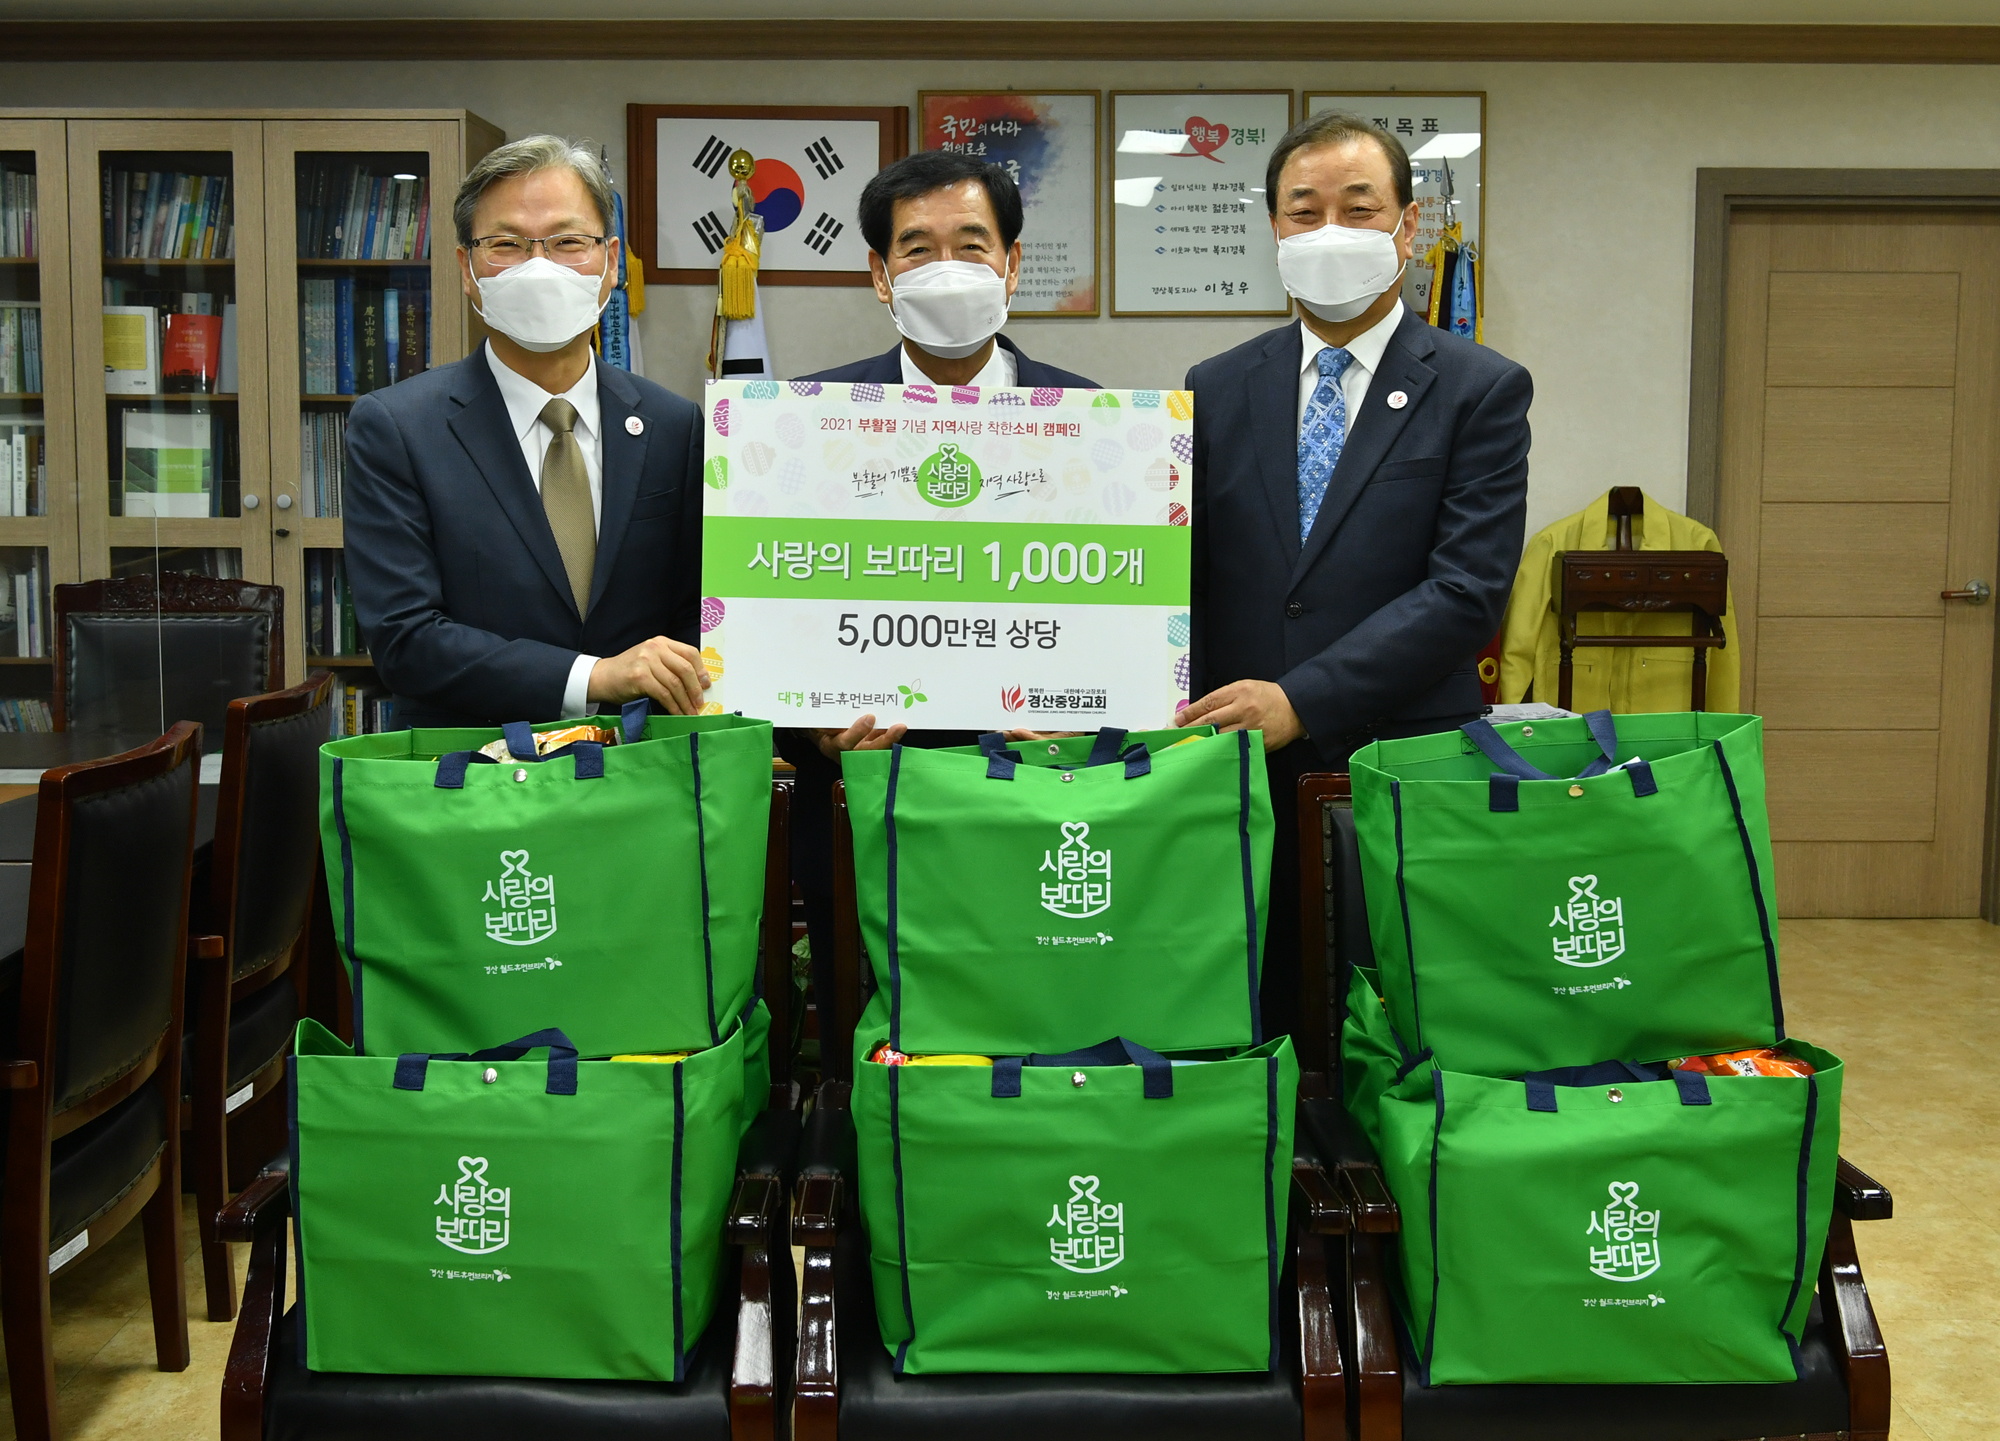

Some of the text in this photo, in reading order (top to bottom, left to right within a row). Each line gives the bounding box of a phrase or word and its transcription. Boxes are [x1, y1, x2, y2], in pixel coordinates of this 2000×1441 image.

[939, 115, 1022, 140] 국민의 나라
[1192, 126, 1220, 145] 행복
[1231, 128, 1265, 145] 경북!
[1212, 182, 1245, 192] 부자경북
[1187, 204, 1208, 213] 행복한
[1212, 203, 1245, 213] 젊은경북
[1211, 224, 1246, 234] 관광경북
[1171, 246, 1191, 254] 이웃과
[1213, 245, 1245, 255] 복지경북
[1152, 286, 1197, 295] 경상북도지사
[820, 418, 1081, 437] 2021 부활절 기념 지역사랑 착한소비 캠페인
[852, 466, 1047, 491] 부활의 기쁨을 지역 사랑으로
[927, 463, 971, 481] 사랑의
[927, 481, 971, 502] 보따리
[747, 540, 1145, 591] 사랑의 보따리 1,000개
[836, 613, 1061, 654] 5,000만원 상당
[778, 691, 899, 709] 대경 월드휴먼브리지
[1028, 694, 1107, 709] 경산중앙교회
[1038, 849, 1111, 881] 사랑의
[481, 875, 555, 909] 사랑의
[1041, 881, 1111, 919] 보따리
[1549, 897, 1623, 933] 사랑의
[485, 906, 557, 946] 보따리
[1035, 936, 1098, 946] 경산 월드휴먼브리지
[1552, 927, 1625, 968] 보따리
[484, 962, 547, 975] 경산 월드휴먼브리지
[1552, 982, 1615, 995] 경산 월드휴먼브리지
[433, 1183, 510, 1219] 사랑의
[1046, 1202, 1124, 1235] 사랑의
[1585, 1209, 1661, 1242] 사랑의
[435, 1215, 510, 1255] 보따리
[1050, 1234, 1125, 1274] 보따리
[1589, 1239, 1661, 1282] 보따리
[430, 1269, 494, 1281] 경산 월드휴먼브리지
[1046, 1290, 1112, 1300] 경산 월드휴먼브리지
[1582, 1298, 1649, 1308] 경산 월드휴먼브리지
